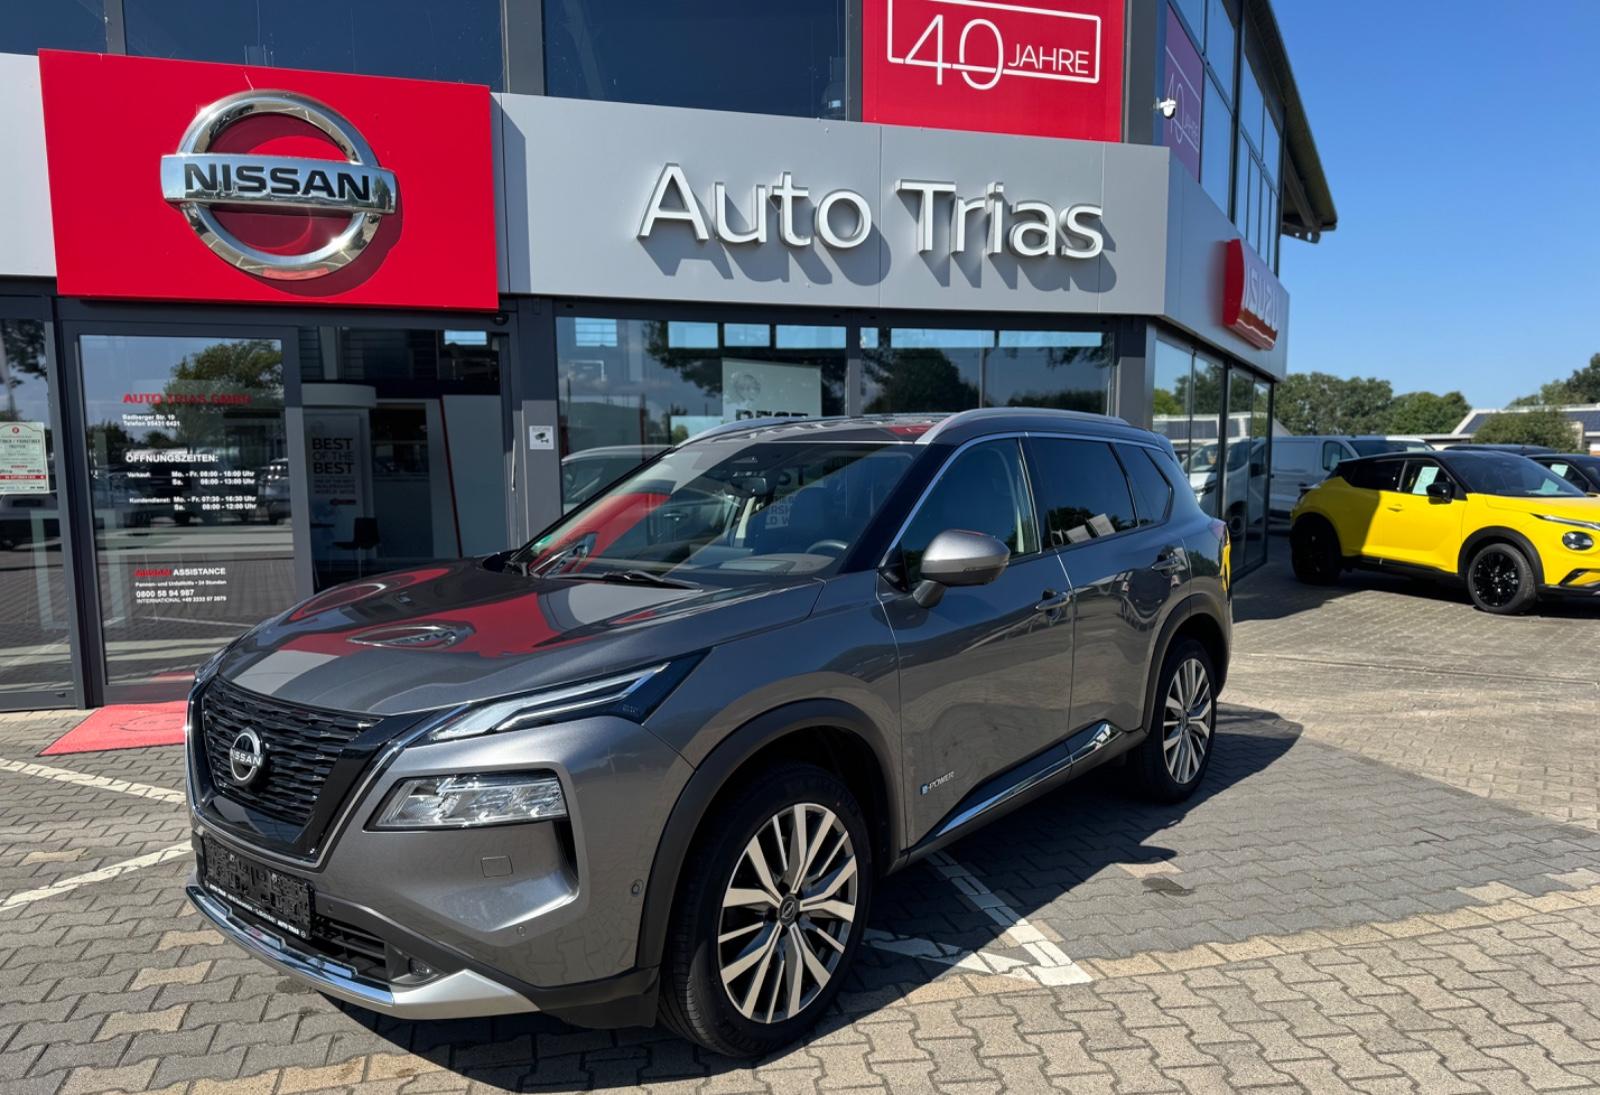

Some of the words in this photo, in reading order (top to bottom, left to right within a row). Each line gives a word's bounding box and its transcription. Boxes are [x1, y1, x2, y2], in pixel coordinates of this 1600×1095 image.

[904, 14, 1004, 90] 40
[1008, 43, 1090, 75] JAHRE
[184, 162, 371, 202] NISSAN
[637, 162, 873, 250] Auto
[897, 178, 1105, 260] Trias
[123, 393, 162, 404] AUTO
[312, 438, 353, 450] BEST
[125, 452, 219, 463] ÖFFNUNGSZEITEN:
[313, 462, 354, 474] BEST
[173, 568, 226, 576] ASSISTANCE
